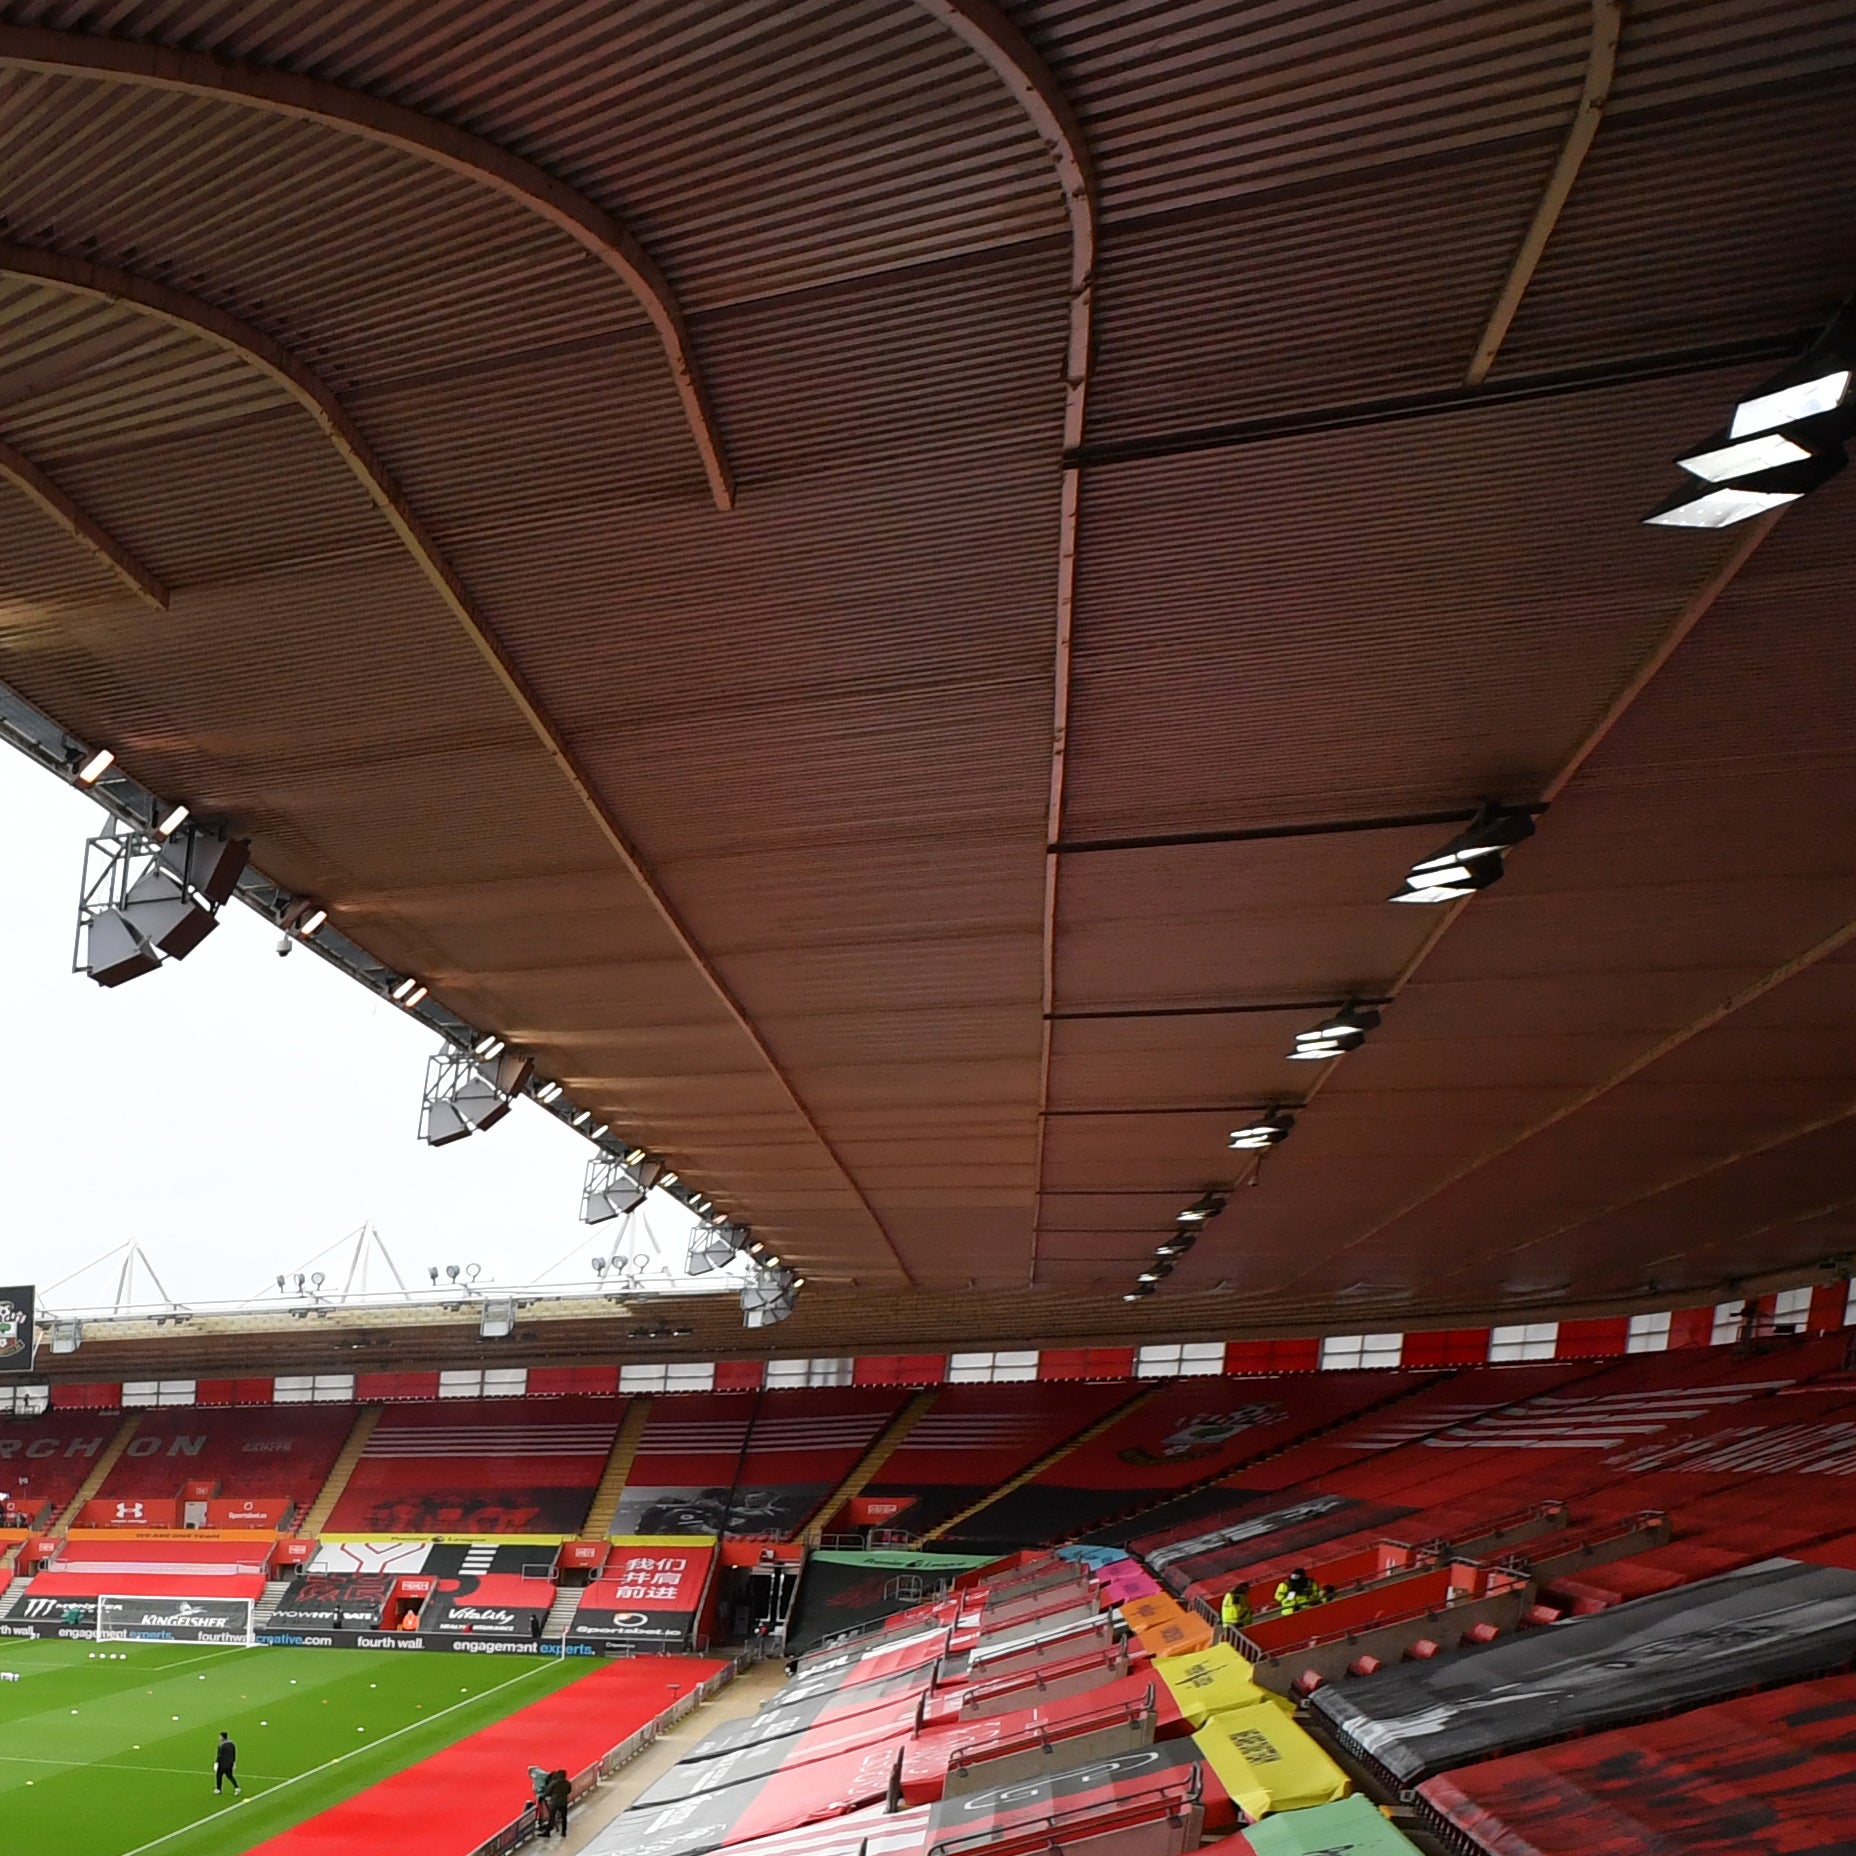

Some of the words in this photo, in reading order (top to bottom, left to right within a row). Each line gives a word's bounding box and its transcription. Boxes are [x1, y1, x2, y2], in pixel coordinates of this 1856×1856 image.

[127, 1435, 208, 1458] ON
[629, 1558, 686, 1571] 我们
[621, 1571, 681, 1585] 并肩
[616, 1585, 678, 1599] 前进
[141, 1614, 229, 1628] KINGFISHER
[447, 1608, 516, 1624] Vitality
[576, 1625, 682, 1637] Sportsbet.io
[197, 1631, 332, 1646] fourthwalcreative.com
[357, 1635, 396, 1648] fourth
[452, 1639, 538, 1655] engagement
[539, 1642, 596, 1657] experts.
